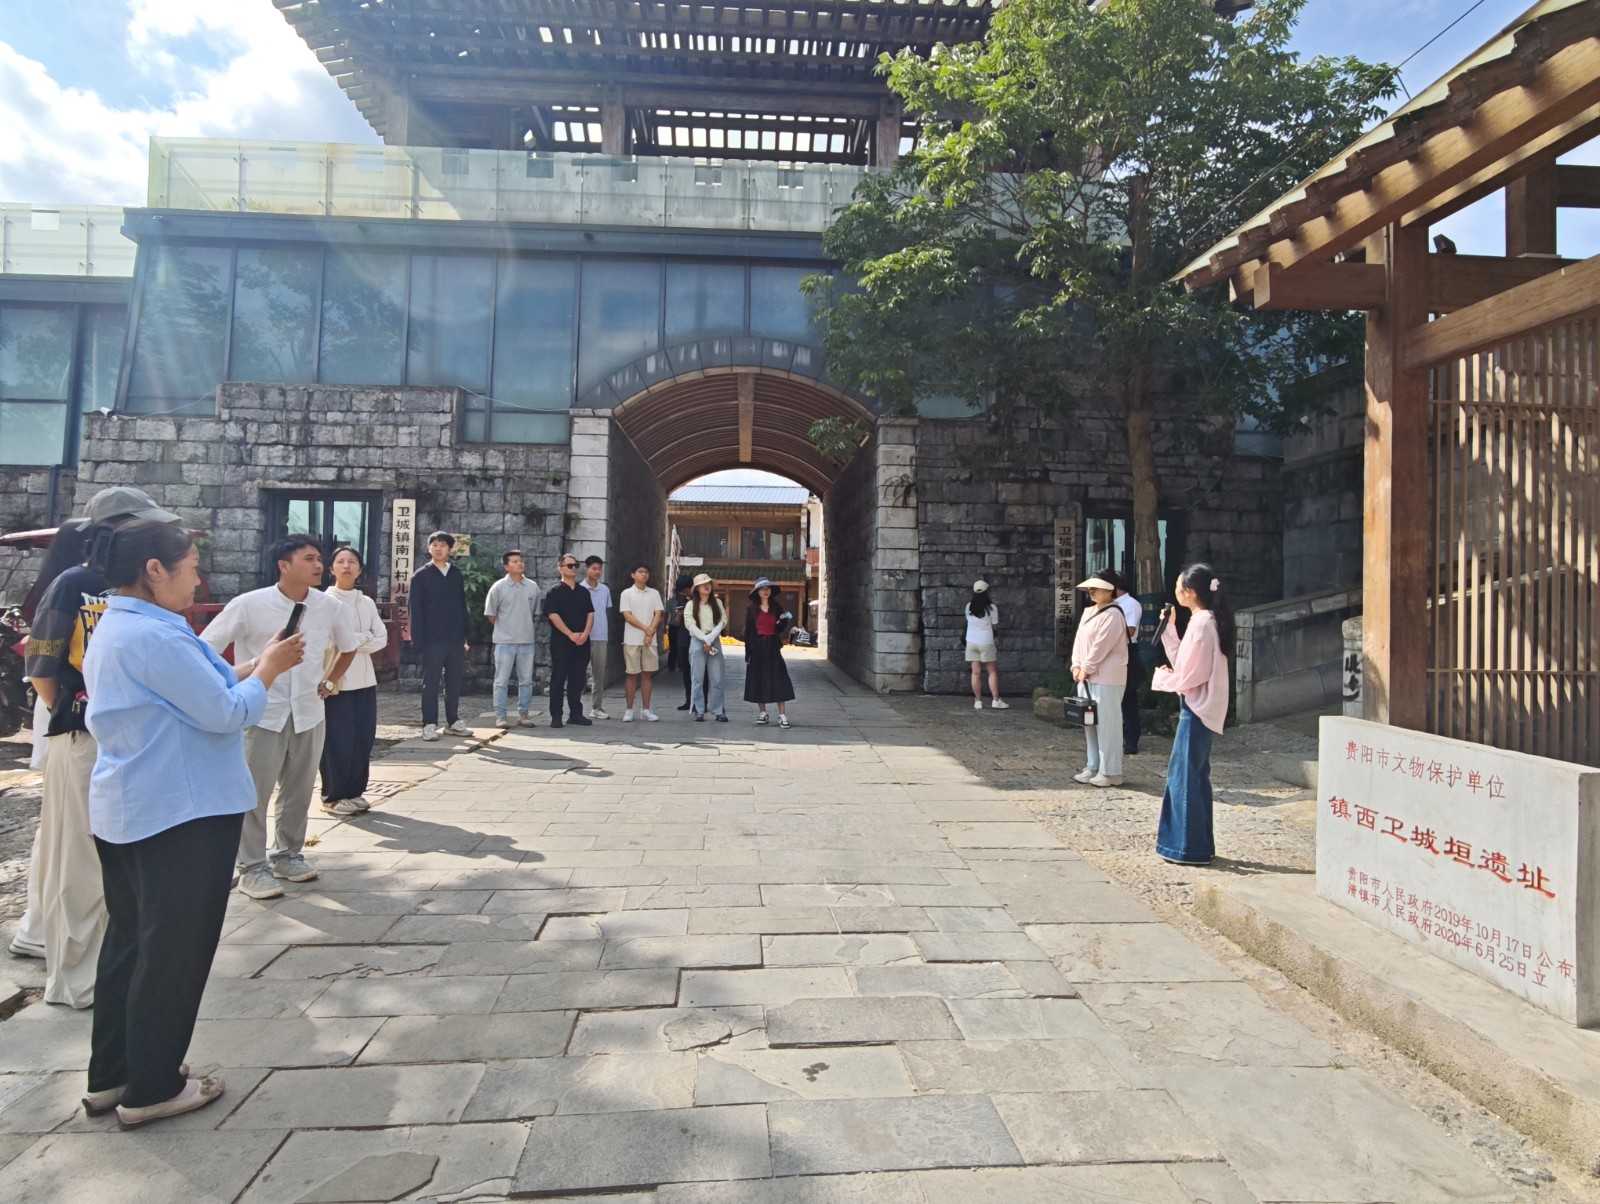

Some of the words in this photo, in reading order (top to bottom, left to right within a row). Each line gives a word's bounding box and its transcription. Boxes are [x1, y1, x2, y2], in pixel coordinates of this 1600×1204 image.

[1345, 740, 1505, 799] 贵阳市文物保护单位
[1328, 796, 1556, 898] 镇西卫城垣遗址
